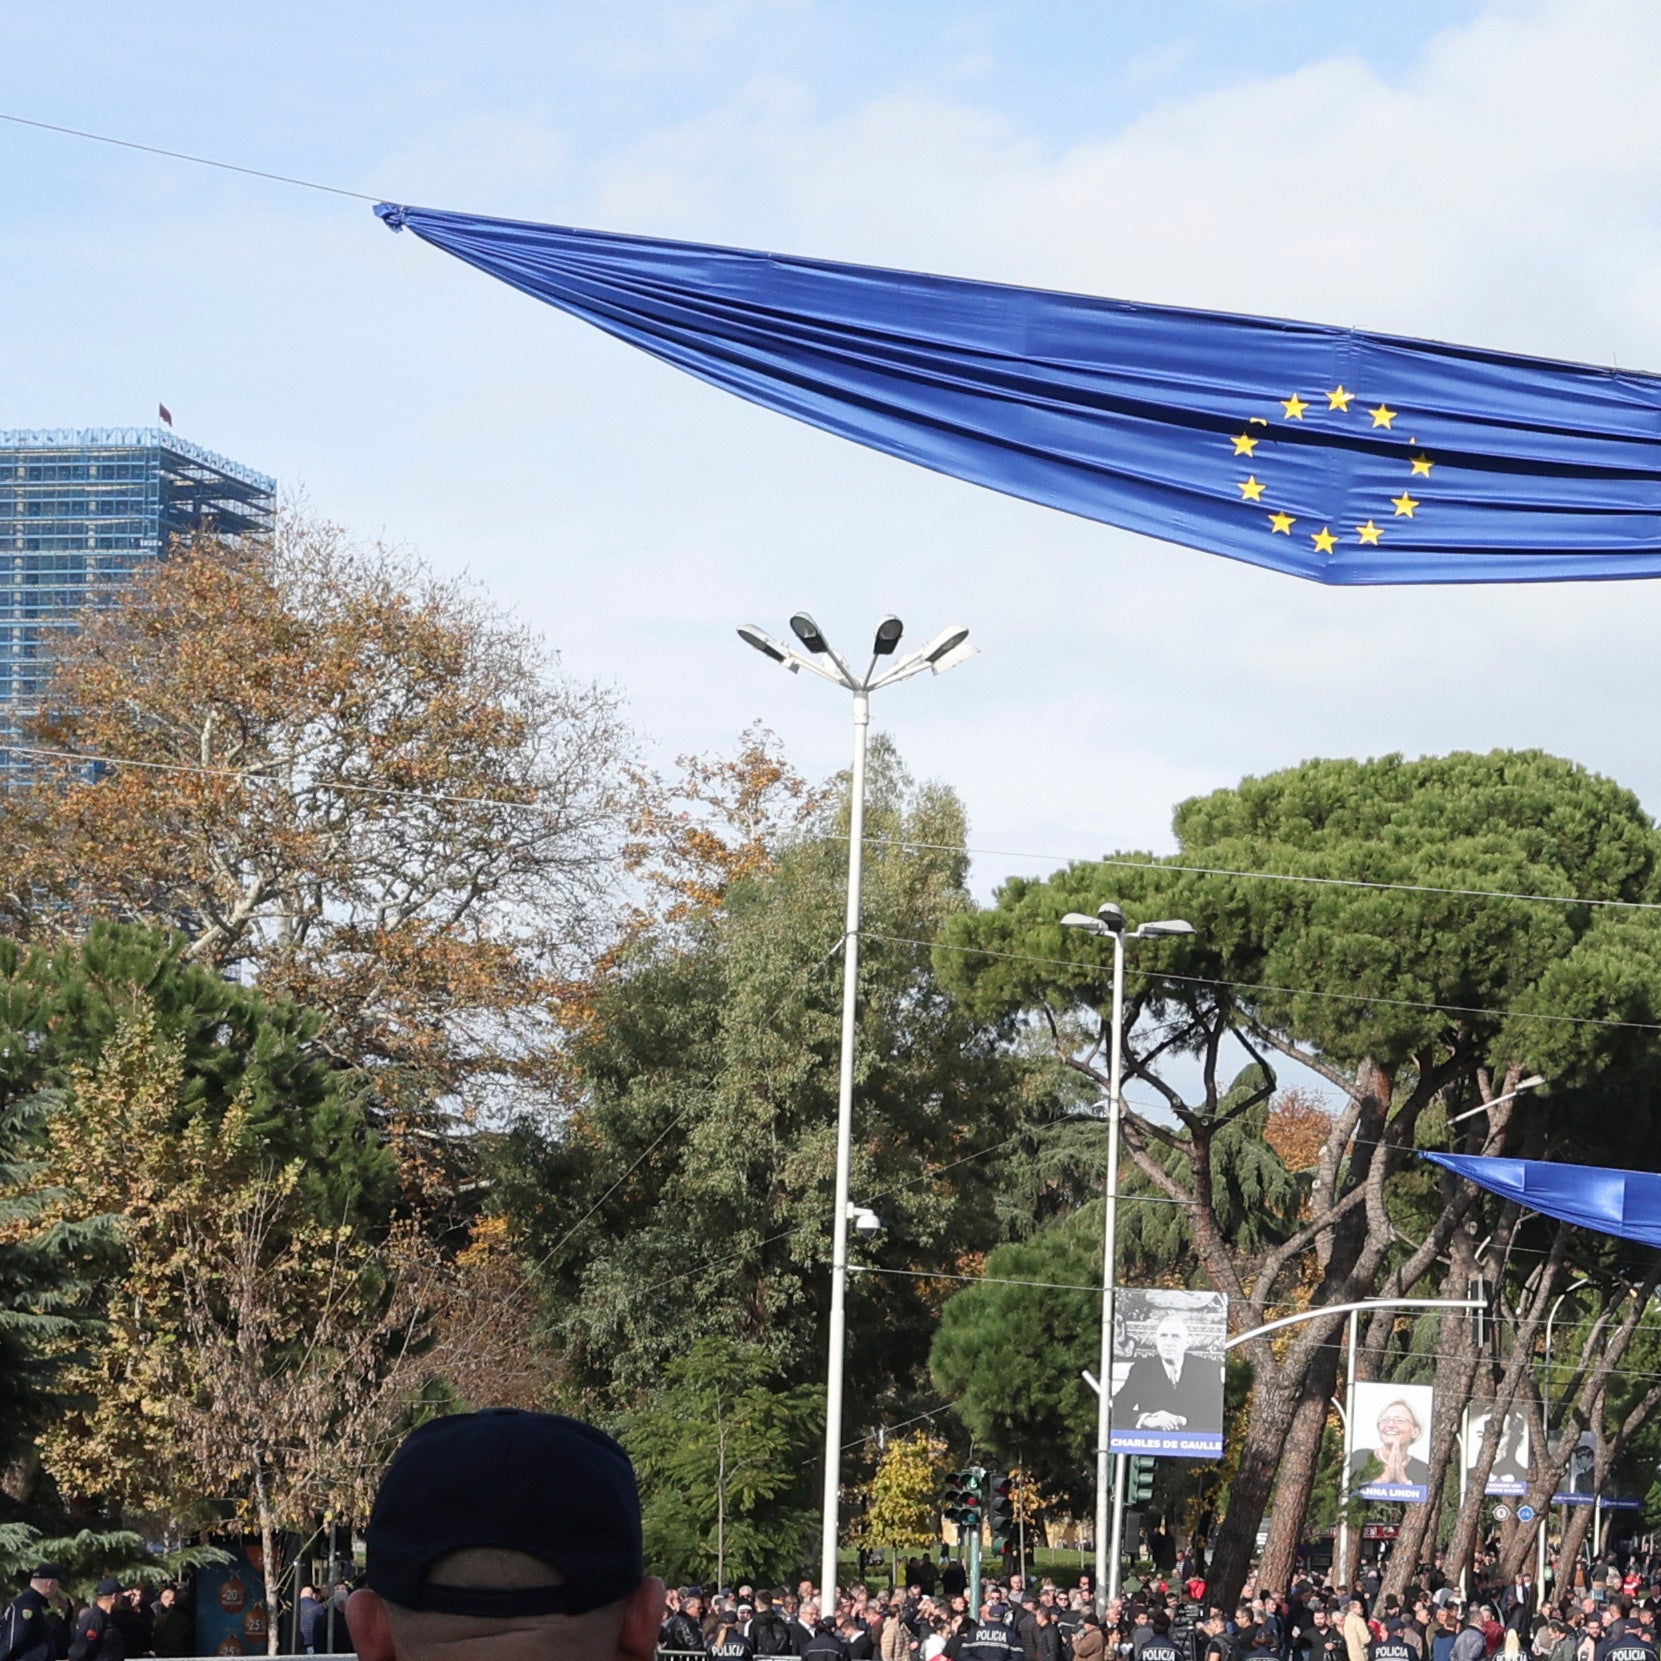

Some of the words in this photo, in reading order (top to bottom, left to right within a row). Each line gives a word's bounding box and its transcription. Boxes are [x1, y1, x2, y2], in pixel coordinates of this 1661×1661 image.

[1110, 1438, 1161, 1448] CHARLES
[1162, 1440, 1179, 1449] DE
[1180, 1441, 1222, 1450] GAULLE
[1389, 1489, 1420, 1498] LINDH
[976, 1630, 1006, 1643] POLICIA
[1143, 1650, 1176, 1661] POLICIA
[1375, 1645, 1409, 1658] POLICIA
[1612, 1649, 1646, 1661] POLICIA
